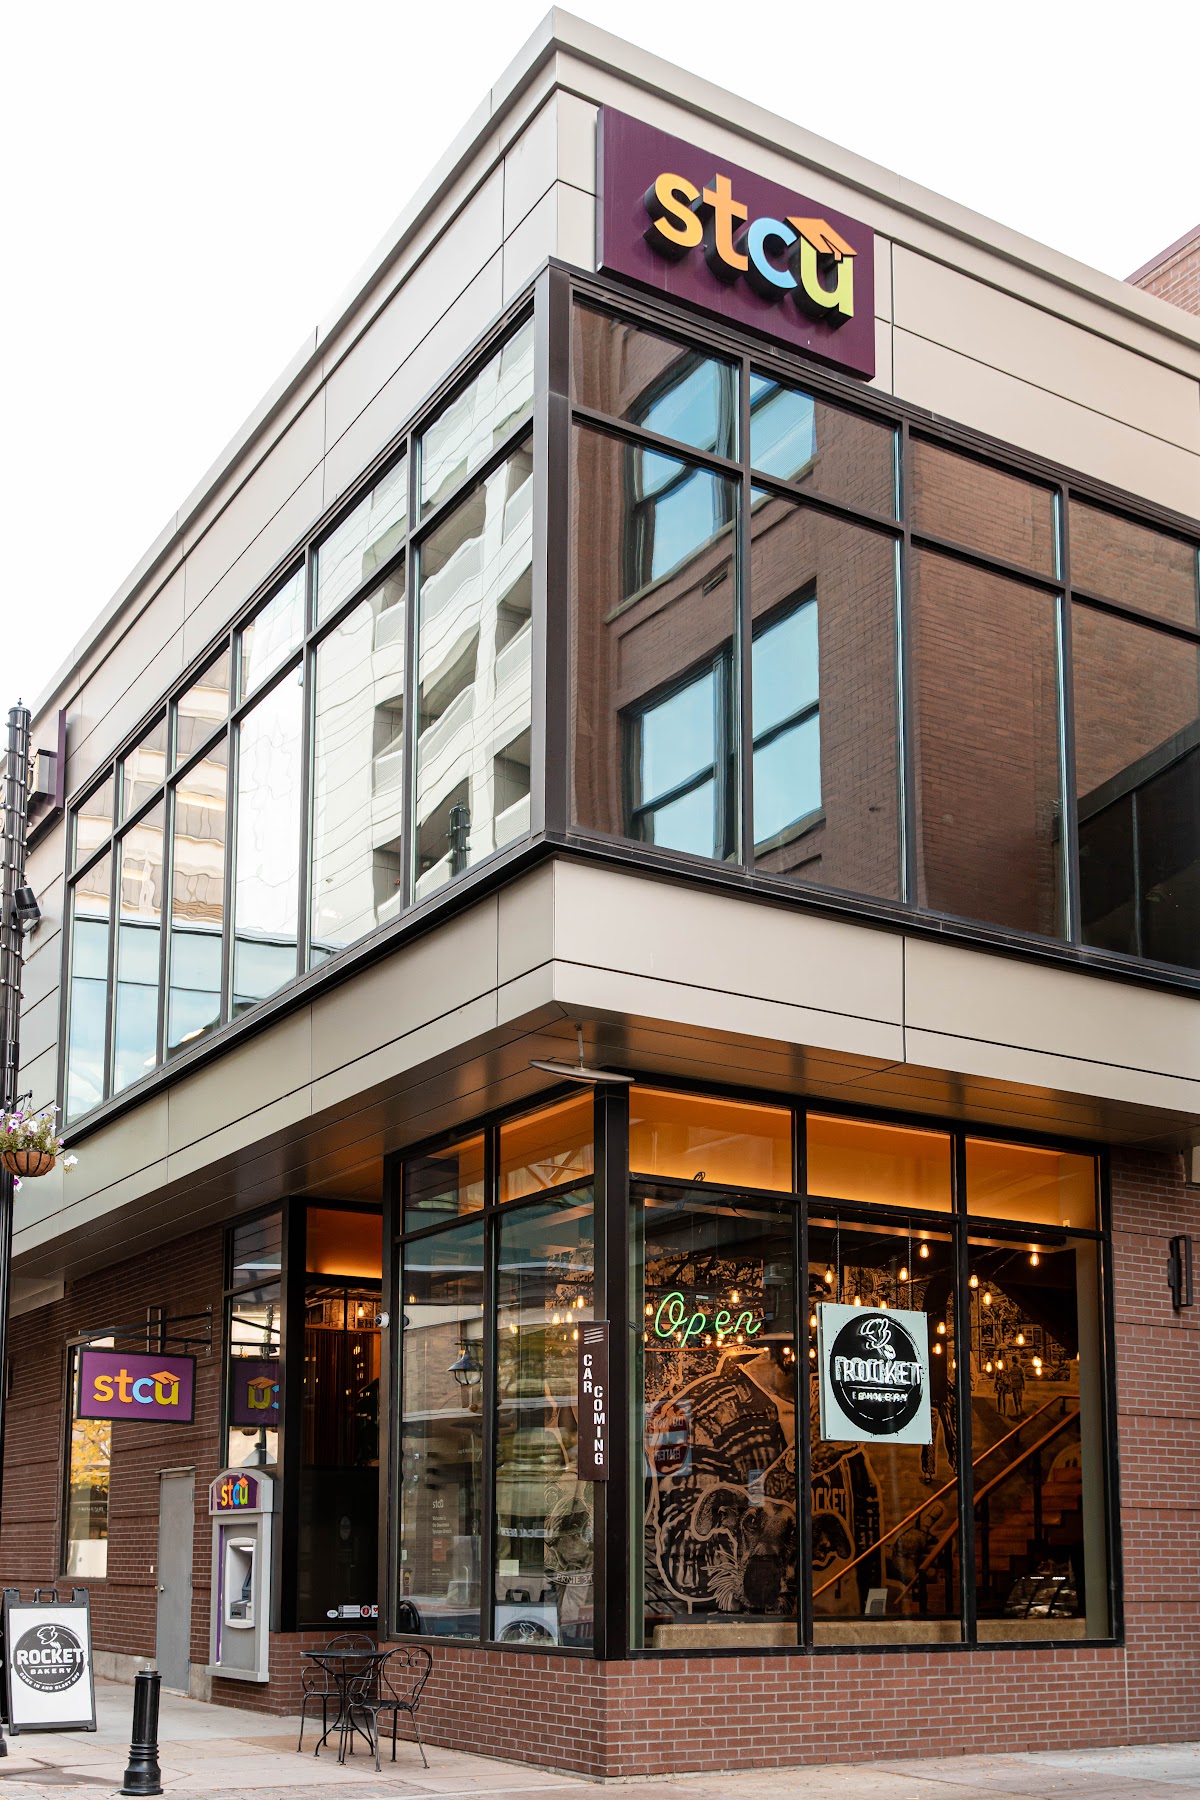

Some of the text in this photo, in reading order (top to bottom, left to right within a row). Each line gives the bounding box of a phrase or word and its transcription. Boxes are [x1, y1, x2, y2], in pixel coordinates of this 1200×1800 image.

[645, 172, 857, 322] stcu
[655, 1292, 762, 1348] Open
[92, 1368, 181, 1406] stcu
[583, 1354, 593, 1393] CAR
[593, 1385, 606, 1465] COMING
[221, 1476, 249, 1506] stcu
[17, 1648, 83, 1665] ROCKET
